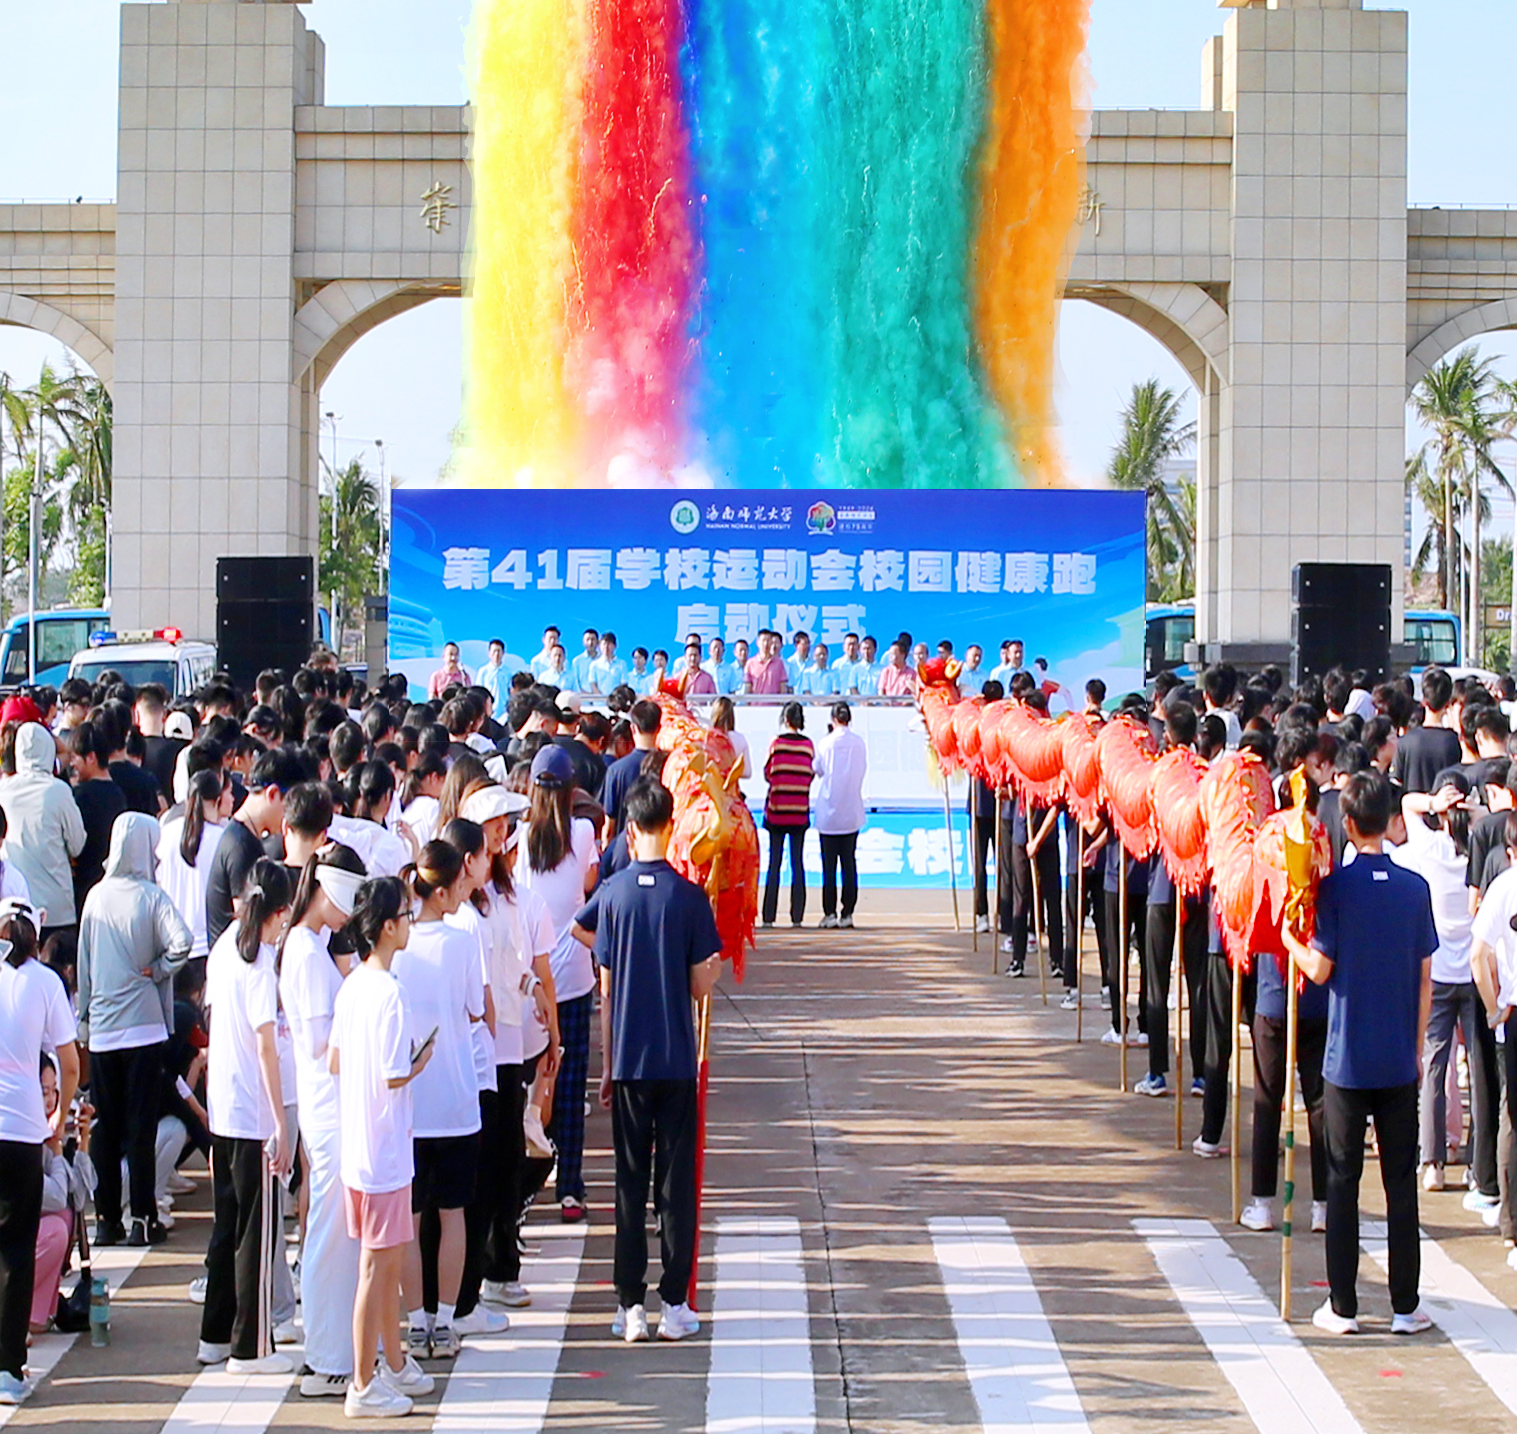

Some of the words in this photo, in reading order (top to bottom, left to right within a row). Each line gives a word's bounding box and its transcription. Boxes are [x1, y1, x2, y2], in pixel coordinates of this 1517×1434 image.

[705, 503, 793, 523] 海南师范大学
[442, 547, 1096, 595] 第41届学校运动会校园健康跑
[675, 602, 867, 646] 启动仪式
